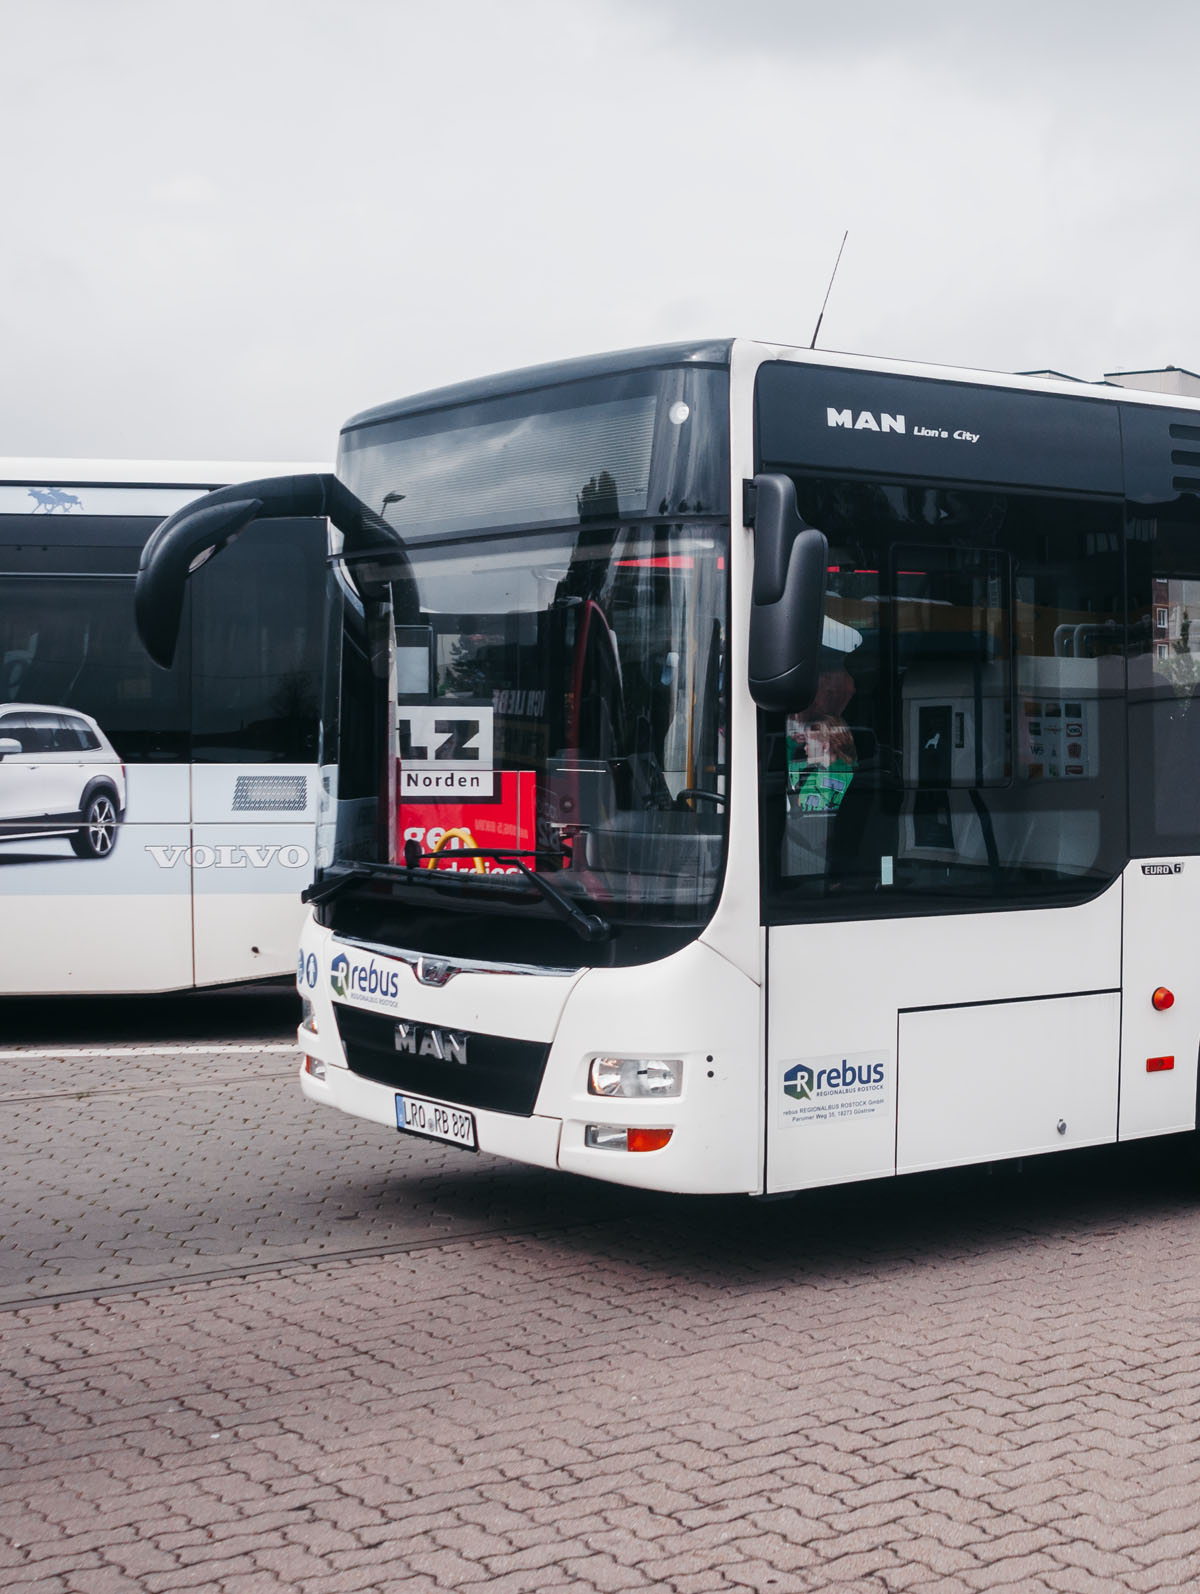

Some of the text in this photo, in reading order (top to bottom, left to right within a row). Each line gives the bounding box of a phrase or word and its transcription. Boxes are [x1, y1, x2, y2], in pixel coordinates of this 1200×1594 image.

[827, 407, 980, 443] MAN Lion's City
[398, 719, 480, 760] LZ
[406, 773, 480, 787] Norden
[144, 845, 310, 868] VOLVO
[1144, 863, 1182, 875] EURO 6
[350, 958, 399, 998] rebus
[394, 1023, 470, 1065] MAN
[816, 1059, 885, 1089] rebus
[816, 1084, 884, 1097] REGIONALBUS ROSTOCK
[403, 1101, 471, 1141] LRO RB 887
[783, 1107, 798, 1116] rebus
[799, 1104, 839, 1114] REGIONALBUS
[840, 1100, 867, 1108] ROSTOCK
[816, 1112, 827, 1120] Weg
